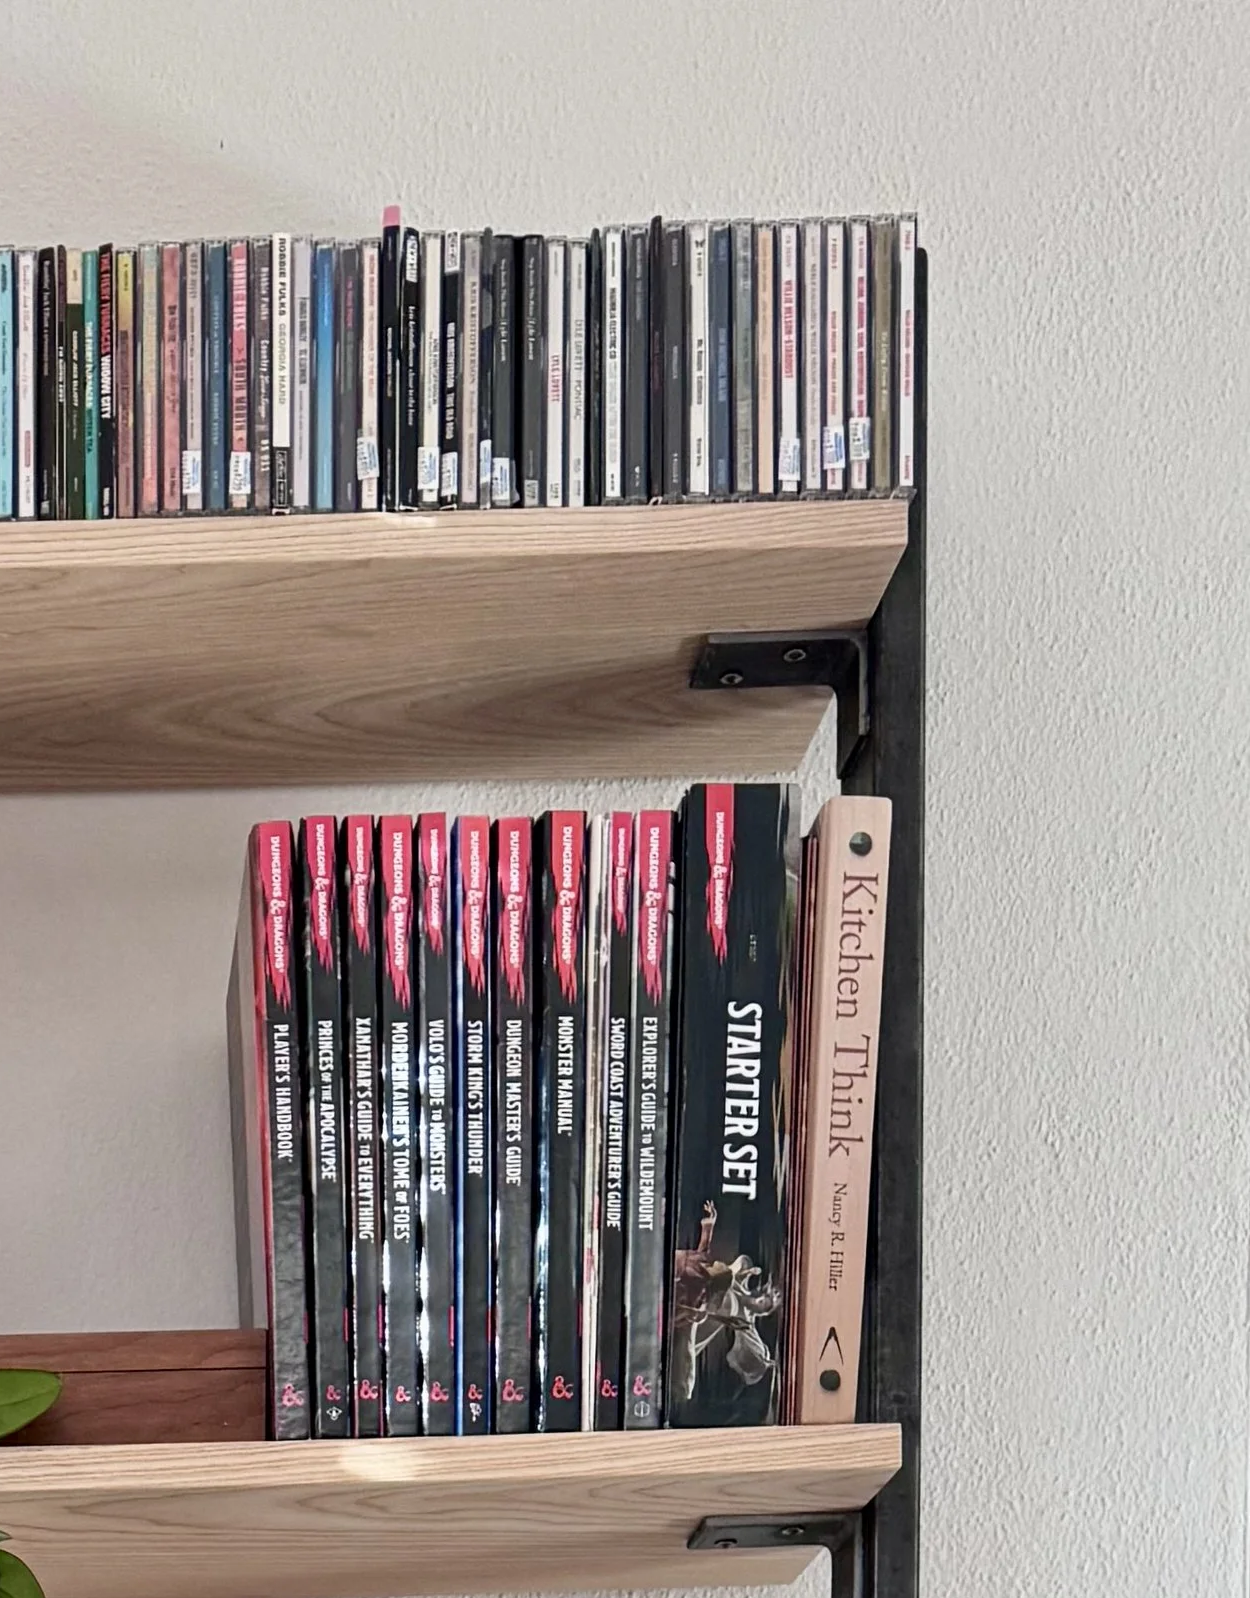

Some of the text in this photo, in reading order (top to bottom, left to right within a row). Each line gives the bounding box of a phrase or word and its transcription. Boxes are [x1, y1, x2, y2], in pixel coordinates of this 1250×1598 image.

[100, 253, 111, 272] THE
[278, 238, 286, 278] ROBBIE
[100, 274, 111, 300] FIERY
[278, 281, 286, 316] FULKS
[100, 355, 111, 391] WIDOW
[278, 323, 286, 372] GEORGIA
[101, 395, 111, 419] CITY
[316, 824, 327, 875] DUNGEONS
[356, 828, 364, 872] DUNGEONS
[393, 832, 403, 894] DUNGEONS
[471, 831, 479, 888] DUNGEONS
[510, 831, 519, 893] DUNGEONS
[562, 826, 573, 888] DUNGEONS
[617, 828, 626, 866] DUNGEONS
[649, 827, 659, 889] DUNGEONS
[715, 812, 724, 864] DUNGEONS
[270, 836, 281, 897] DUNGEONS
[318, 892, 327, 936] DRAGONS
[357, 885, 365, 924] DRAGONS
[431, 887, 439, 926] DRAGONS
[617, 877, 625, 910] DRAGONS
[715, 879, 723, 924] DRAGONS
[273, 916, 284, 968] DRAGONS
[395, 913, 403, 966] DRAGONS
[471, 906, 479, 956] DRAGONS
[510, 911, 519, 964] DRAGONS
[561, 907, 572, 960] DRAGONS
[648, 908, 658, 960] DRAGONS
[828, 871, 880, 1158] Kitchen Think
[273, 1024, 292, 1159] PLAYER'S HANDBOOK
[318, 1020, 336, 1179] PRINCES OF THE APOCALYPSE
[467, 1021, 483, 1174] STORM KING'S THUNDER
[505, 1020, 522, 1184] DUNGEON MASTER'S GUIDE
[557, 1016, 574, 1135] MONSTER MANUAL
[721, 1001, 763, 1200] STARTER SET
[355, 1018, 374, 1239] XANATHAR'S GUIDE TO EVERYTHING
[391, 1022, 410, 1240] MORDENKAINEN'S TOME OF FOES
[428, 1020, 445, 1191] VOLO'S GUIDE TO MONSTERS
[607, 1017, 625, 1228] SWORD COAST ADVENTURER'S GUIDE
[638, 1017, 658, 1230] EXPLORER'S GUIDE TO WILDEMOUNT
[828, 1182, 847, 1292] Nancy R. Hiller
